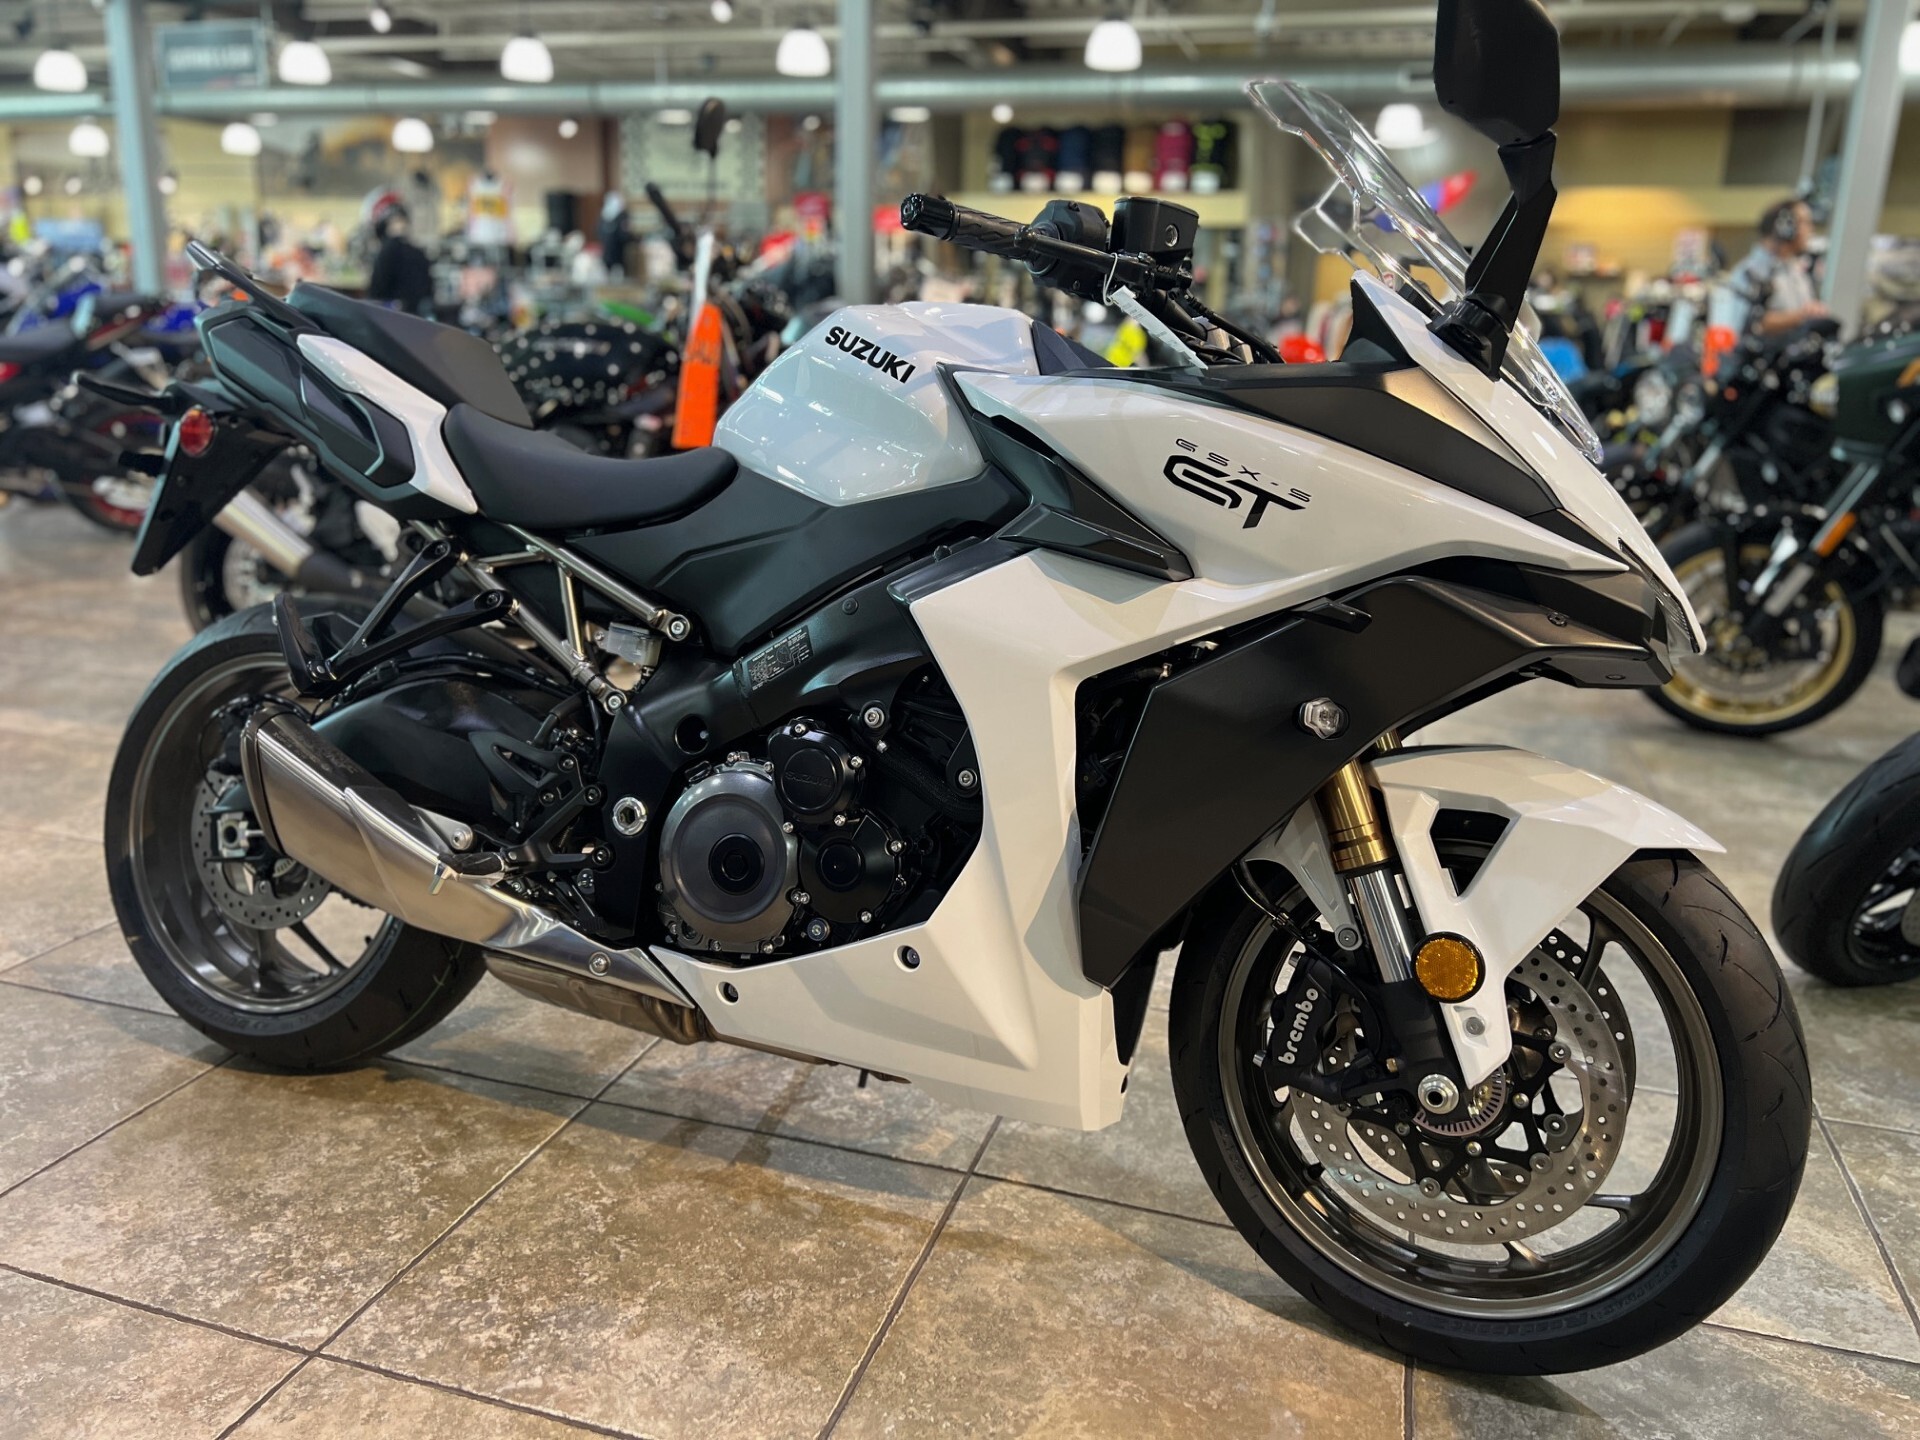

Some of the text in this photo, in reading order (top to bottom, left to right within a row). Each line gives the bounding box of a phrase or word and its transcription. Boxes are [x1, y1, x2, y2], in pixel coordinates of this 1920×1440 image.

[825, 326, 916, 384] SUZUKI
[1163, 454, 1306, 530] GT
[1278, 988, 1319, 1065] brembo
